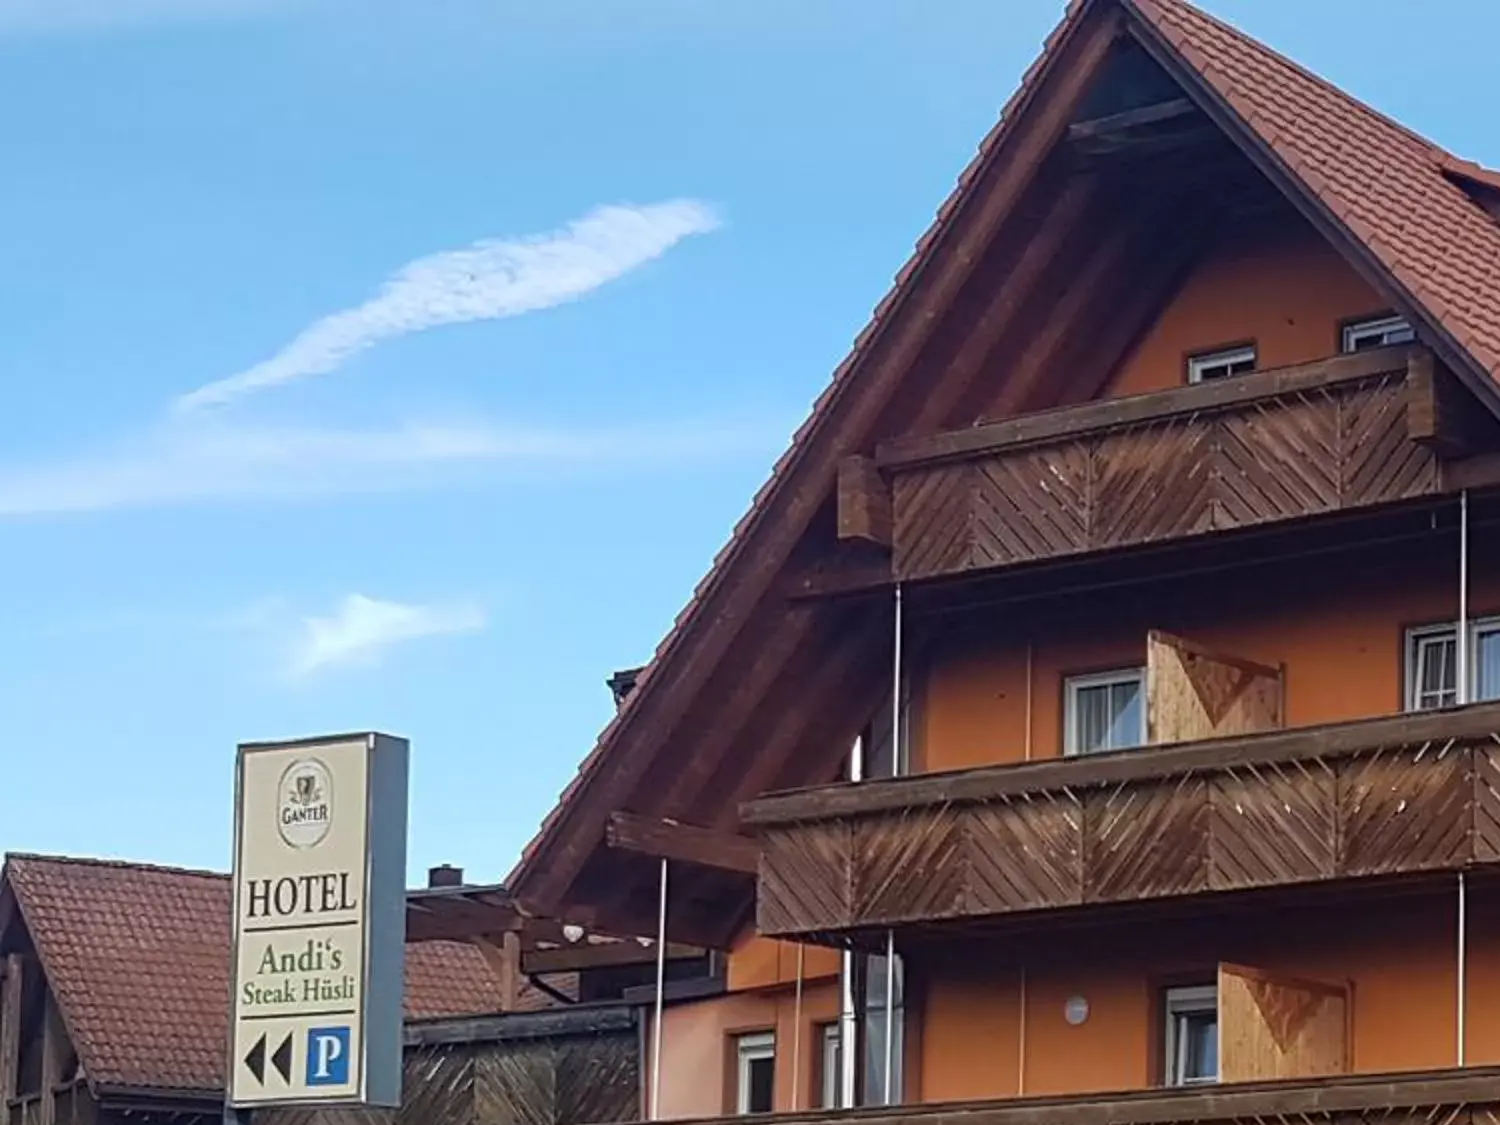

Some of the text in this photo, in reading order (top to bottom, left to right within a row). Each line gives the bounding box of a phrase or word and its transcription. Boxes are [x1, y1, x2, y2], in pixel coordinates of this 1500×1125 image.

[281, 804, 327, 825] GANTER
[247, 872, 357, 917] HOTEL
[243, 975, 355, 1005] Steak Hüsli
[315, 1035, 341, 1078] P
